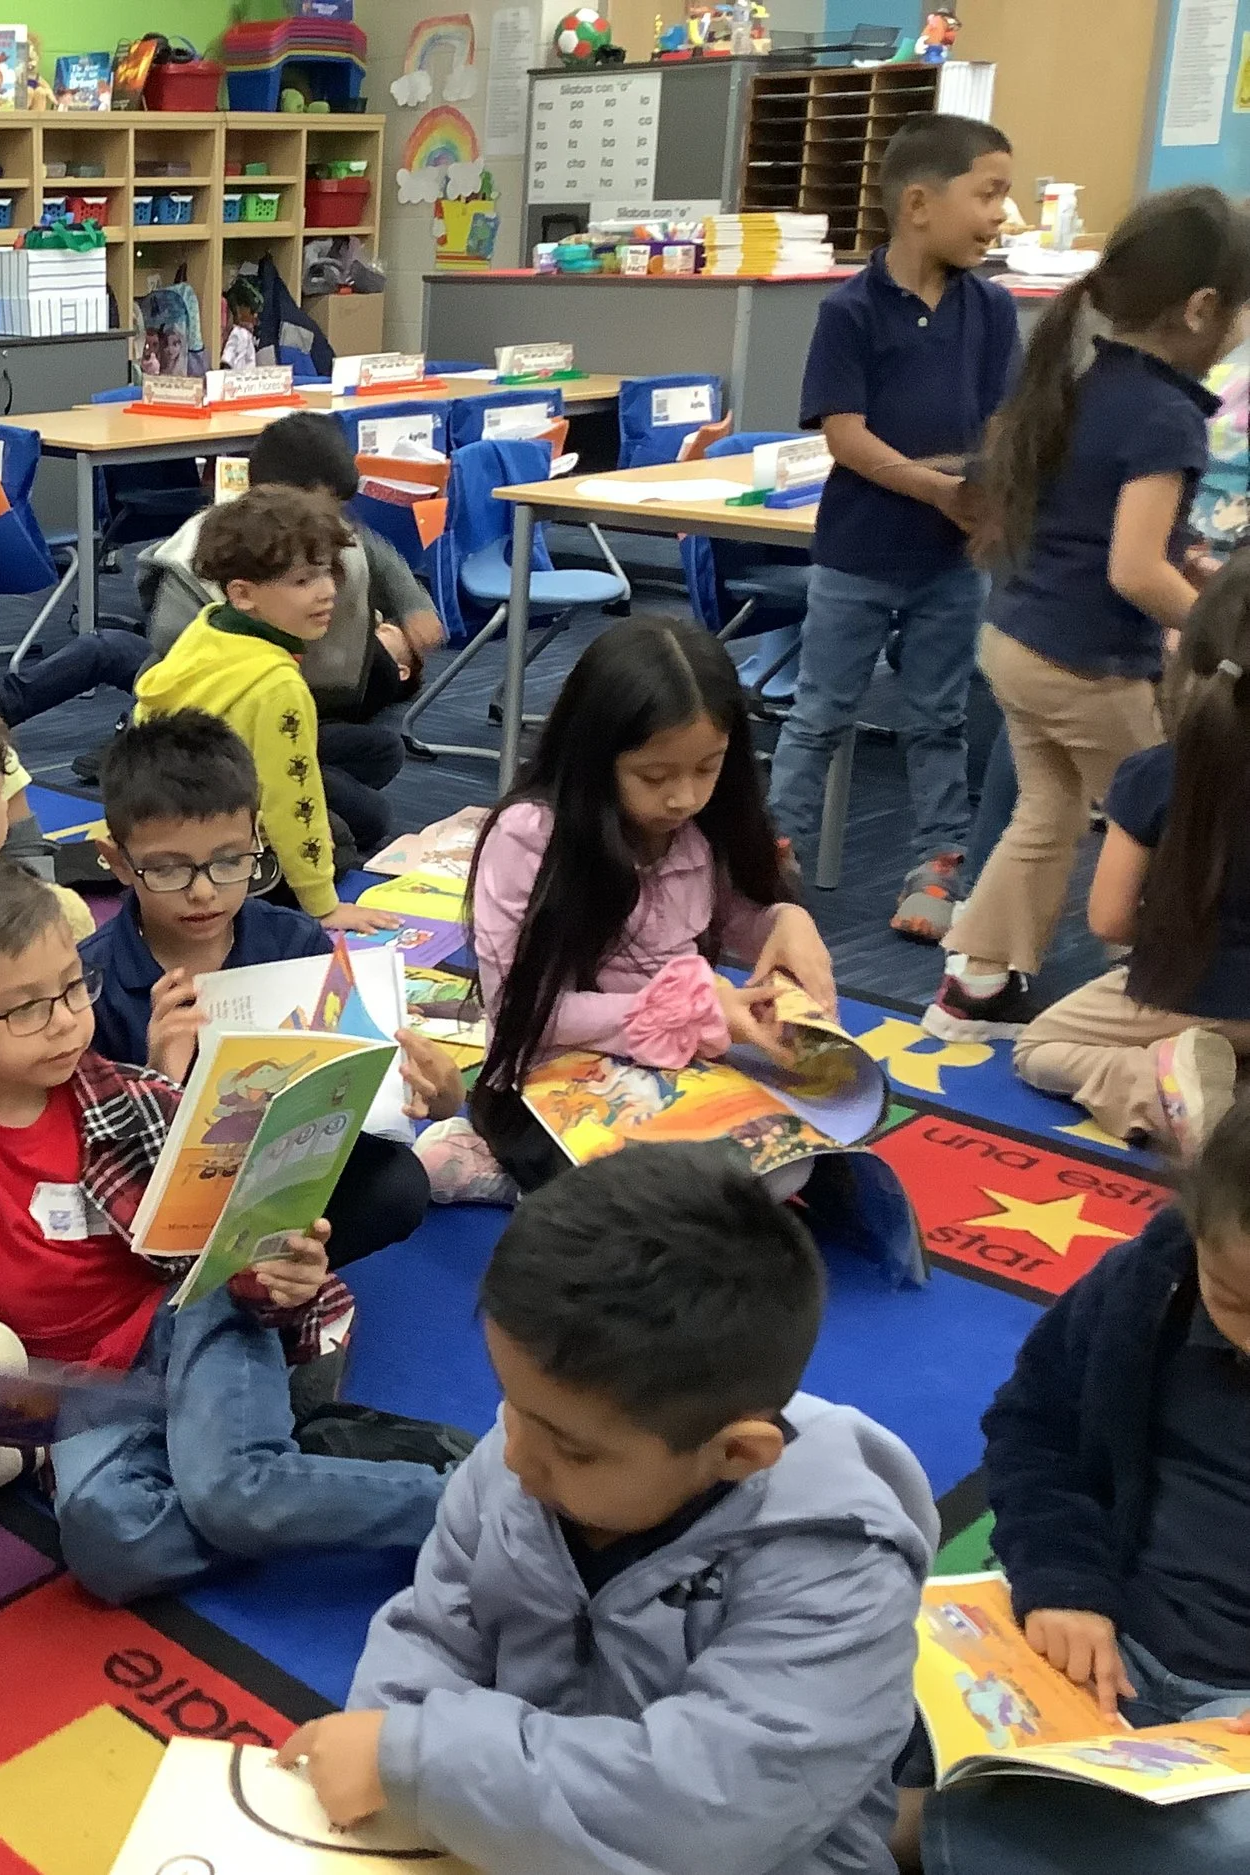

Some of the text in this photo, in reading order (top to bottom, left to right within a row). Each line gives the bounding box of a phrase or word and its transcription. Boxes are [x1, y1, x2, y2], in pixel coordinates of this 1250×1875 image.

[595, 84, 613, 93] con
[538, 101, 554, 111] ma
[570, 100, 584, 112] pa
[569, 119, 583, 129] da
[638, 116, 652, 126] ca
[536, 141, 548, 150] na
[601, 136, 615, 148] ba
[535, 160, 547, 172] ga
[566, 158, 586, 169] cha
[922, 1126, 1040, 1171] una
[926, 1225, 1054, 1273] star
